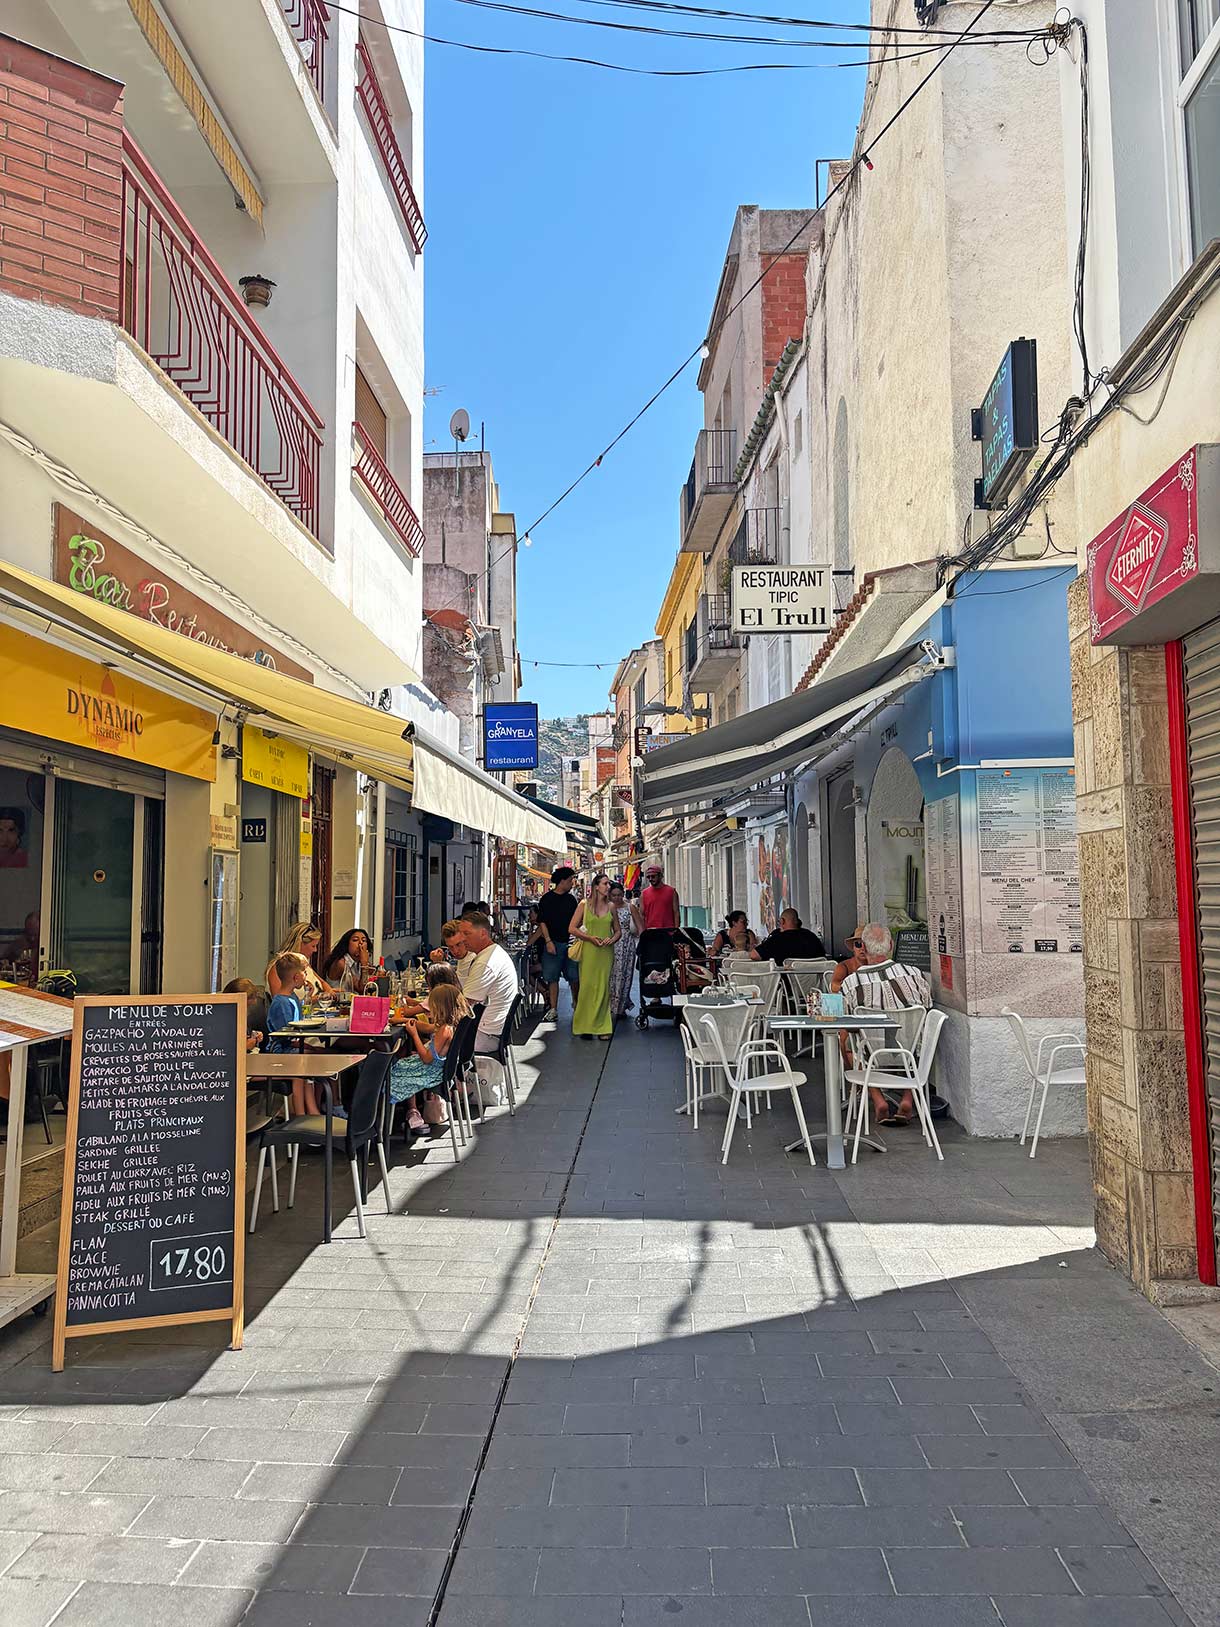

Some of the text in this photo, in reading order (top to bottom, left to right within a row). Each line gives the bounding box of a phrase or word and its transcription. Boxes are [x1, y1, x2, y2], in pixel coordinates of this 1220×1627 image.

[1117, 527, 1154, 583] ETERNITÉ
[741, 570, 824, 588] RESTAURANT
[768, 591, 799, 603] TIPIC
[739, 607, 827, 626] El Trull
[67, 688, 143, 736] DYNAMIC
[108, 1004, 213, 1020] MENU DE JOUR
[85, 1028, 204, 1041] GAZPACHO ANDALUZ
[85, 1043, 125, 1053] MOULES
[83, 1055, 130, 1066] CREVETTES
[132, 1054, 142, 1062] DE
[144, 1051, 169, 1061] ROSES
[83, 1061, 195, 1077] CARPACCIO DE POULPE
[82, 1076, 120, 1087] TARTARE
[122, 1075, 132, 1084] DE
[134, 1073, 171, 1084] SAUMON
[83, 1087, 110, 1098] PETITS
[112, 1083, 161, 1096] CALAMARS
[81, 1098, 113, 1109] SALADE
[115, 1098, 126, 1108] DE
[127, 1097, 168, 1108] FROMAGE
[169, 1096, 179, 1105] DE
[209, 1094, 225, 1102] AUX
[109, 1108, 167, 1121] FRUITS SECS
[114, 1115, 204, 1131] PLATS PRINCIPAUX
[150, 1128, 201, 1141] MOSSELINE
[78, 1146, 118, 1159] SARDINE
[78, 1159, 110, 1171] SEICHE
[77, 1163, 195, 1184] POULET AU CURRY AVEC RIZ
[76, 1183, 105, 1196] PAILLA
[109, 1181, 126, 1193] AUX
[129, 1178, 160, 1191] FRUITS
[165, 1177, 175, 1186] DE
[178, 1173, 198, 1184] MER
[75, 1198, 101, 1211] FIDEU
[106, 1195, 125, 1208] AUX
[128, 1191, 161, 1206] FRUITS
[163, 1189, 174, 1201] DE
[177, 1186, 196, 1199] MER
[75, 1204, 151, 1224] STEAK GRILLÉ
[103, 1210, 195, 1235] DESSERT OU CAFÉ
[73, 1236, 107, 1252] FLAN
[70, 1251, 108, 1266] GLACE
[159, 1246, 226, 1280] 17,80
[69, 1263, 121, 1281] BROWNIE
